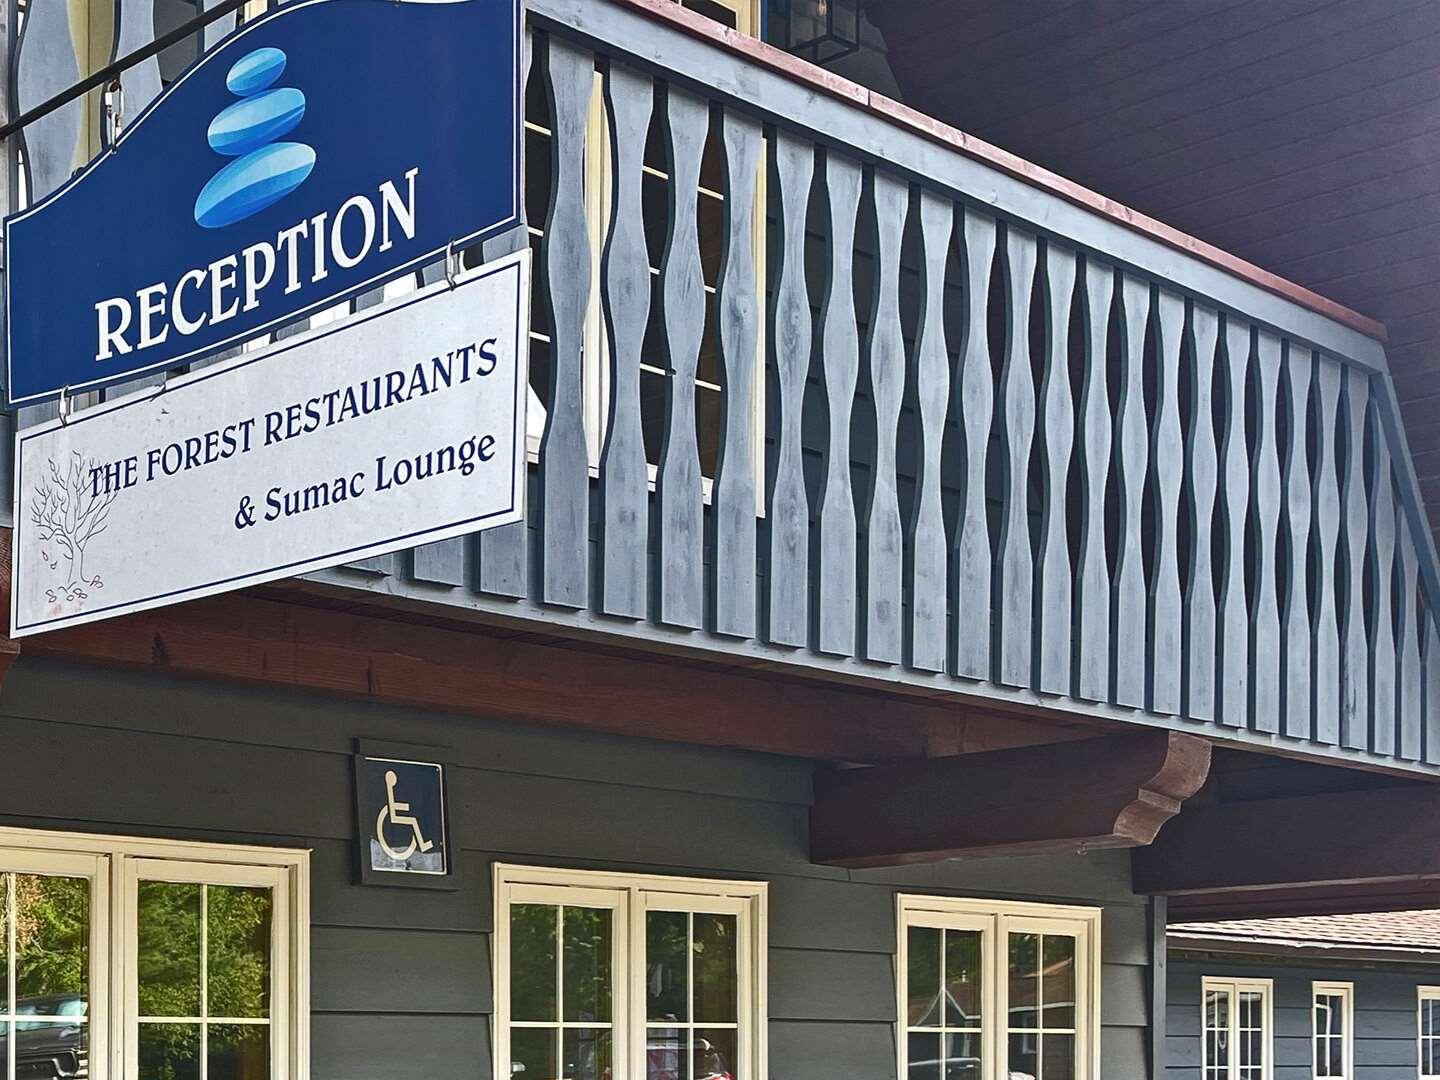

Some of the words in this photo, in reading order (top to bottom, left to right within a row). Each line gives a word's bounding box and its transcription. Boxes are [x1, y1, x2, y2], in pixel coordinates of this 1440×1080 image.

[95, 167, 419, 361] RECEPTION
[87, 455, 138, 499] THE
[146, 418, 255, 482] FOREST
[263, 337, 497, 446] RESTAURANTS
[234, 495, 257, 530] &
[264, 472, 365, 522] Sumac
[375, 434, 496, 492] Lounge
